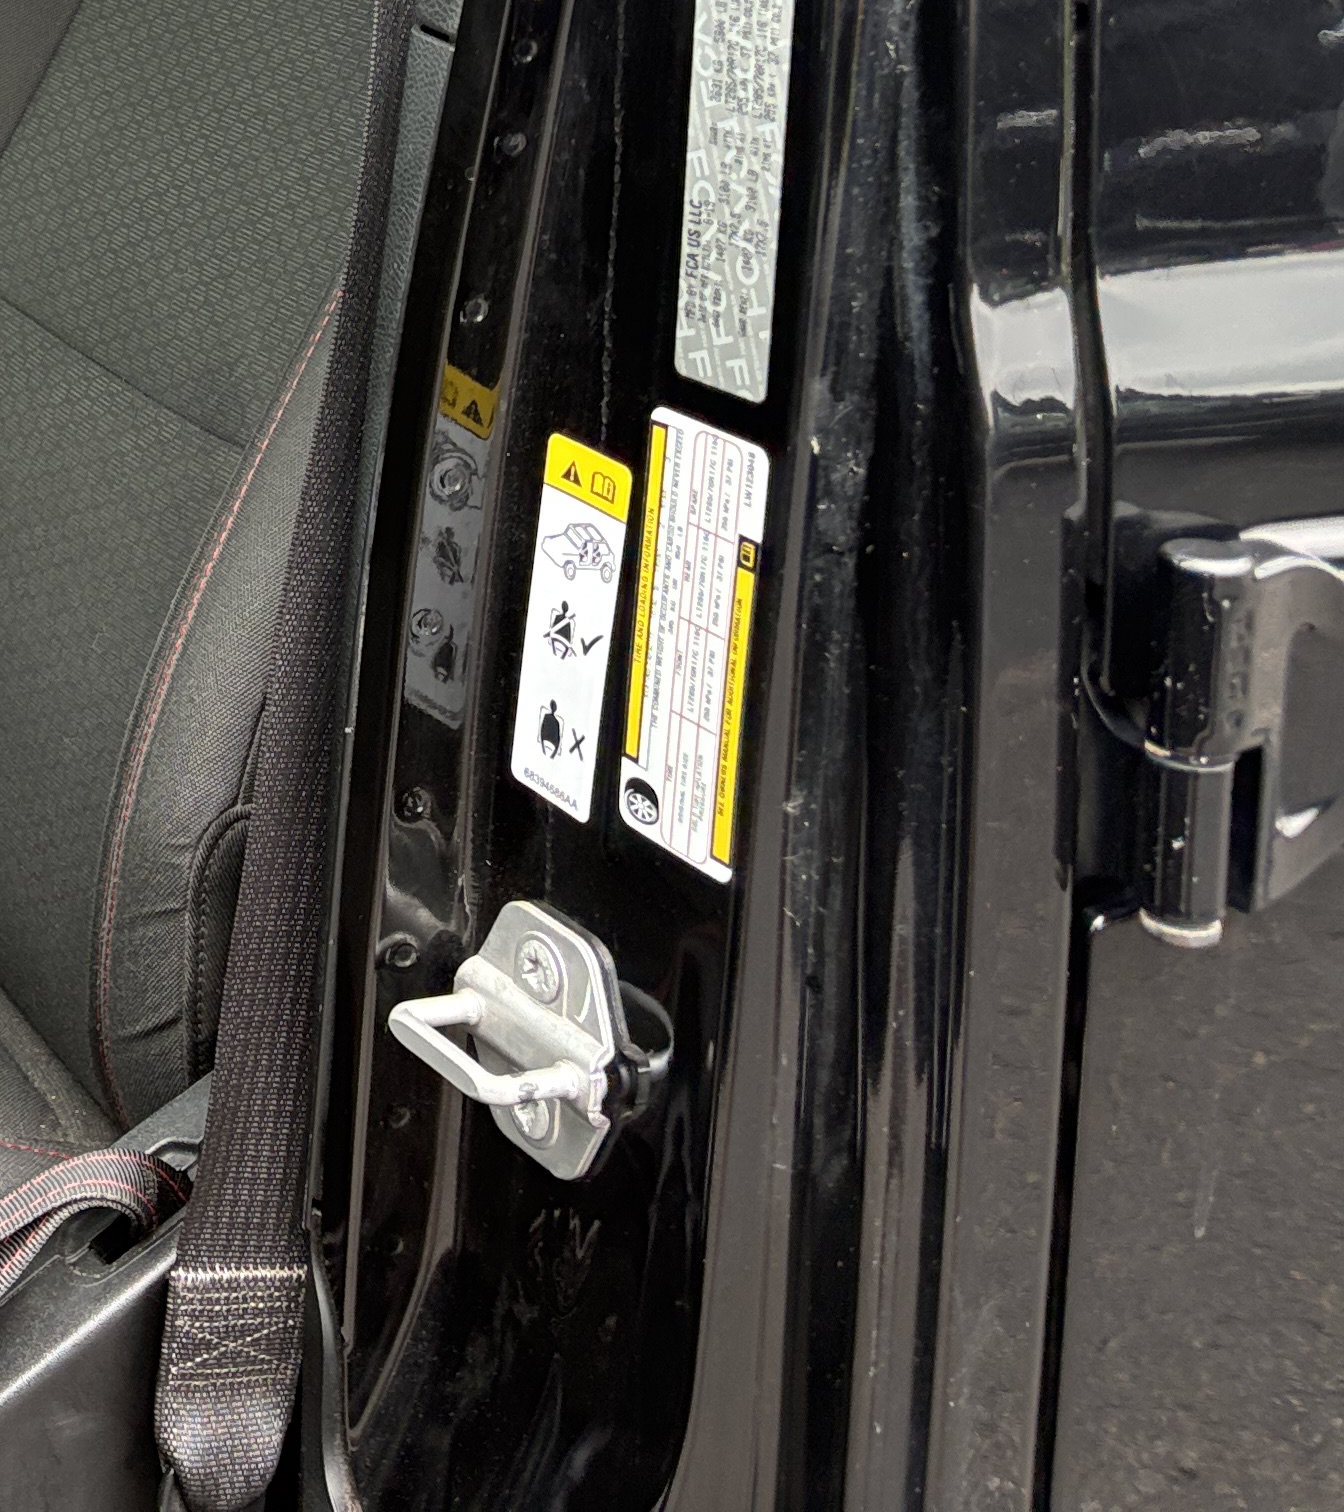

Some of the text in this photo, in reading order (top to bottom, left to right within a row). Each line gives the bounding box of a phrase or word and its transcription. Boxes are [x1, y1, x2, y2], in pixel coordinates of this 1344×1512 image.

[688, 197, 702, 225] LLC
[687, 227, 700, 249] US
[685, 251, 698, 279] FCA
[642, 505, 654, 574] INFORMATION
[638, 574, 648, 618] LOADING
[636, 618, 644, 640] AND
